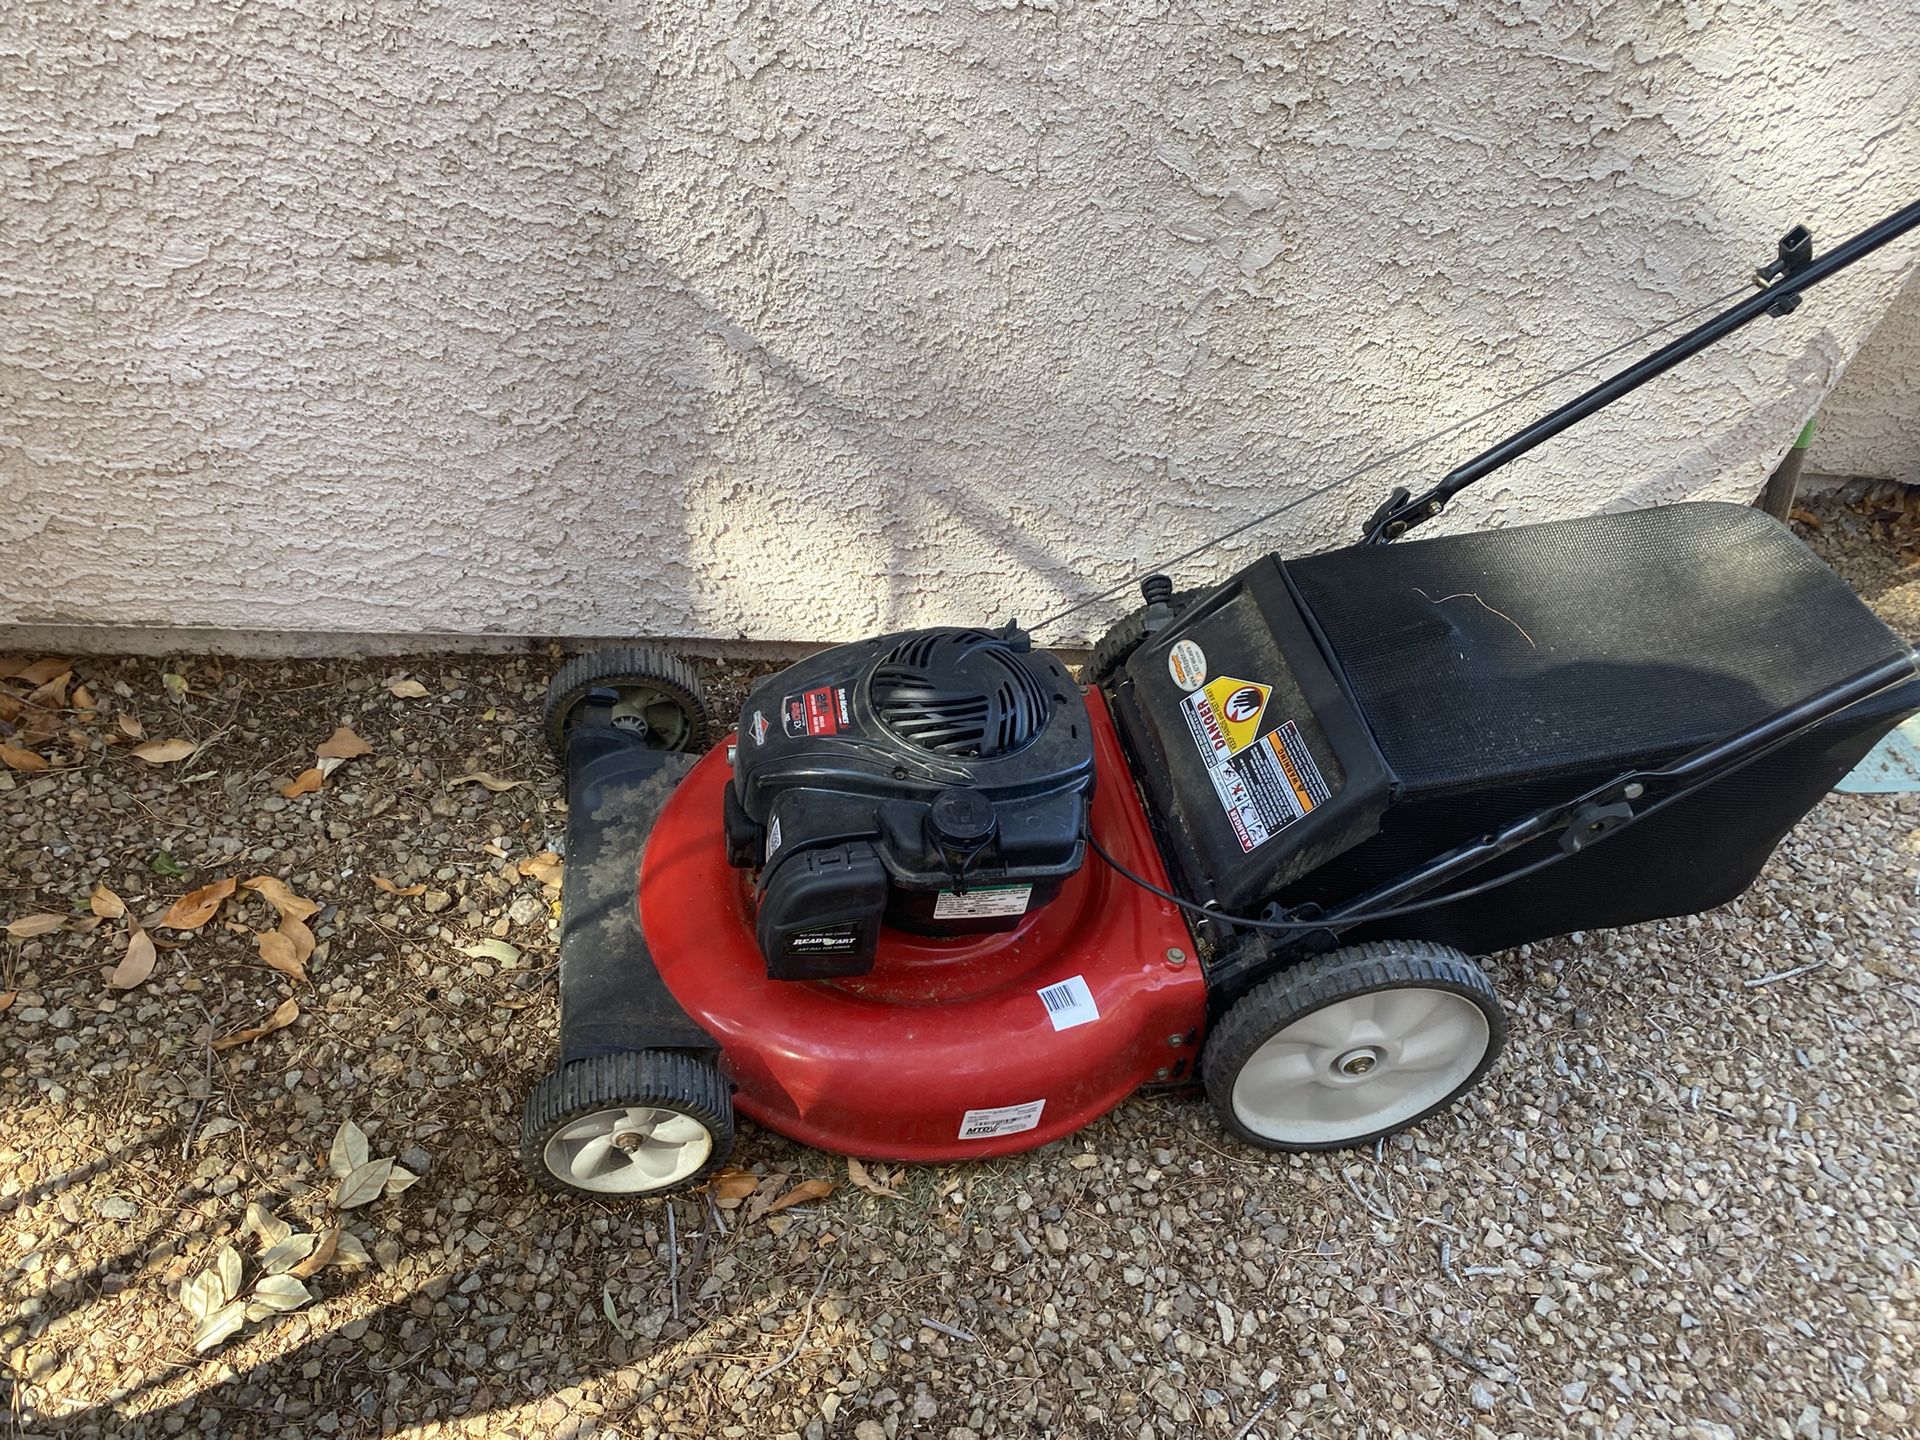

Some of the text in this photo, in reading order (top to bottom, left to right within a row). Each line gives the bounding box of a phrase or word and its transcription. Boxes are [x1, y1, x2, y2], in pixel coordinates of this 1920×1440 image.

[1196, 698, 1226, 751] DANGER
[1276, 747, 1299, 785] WARNING
[1229, 809, 1248, 842] DANGER
